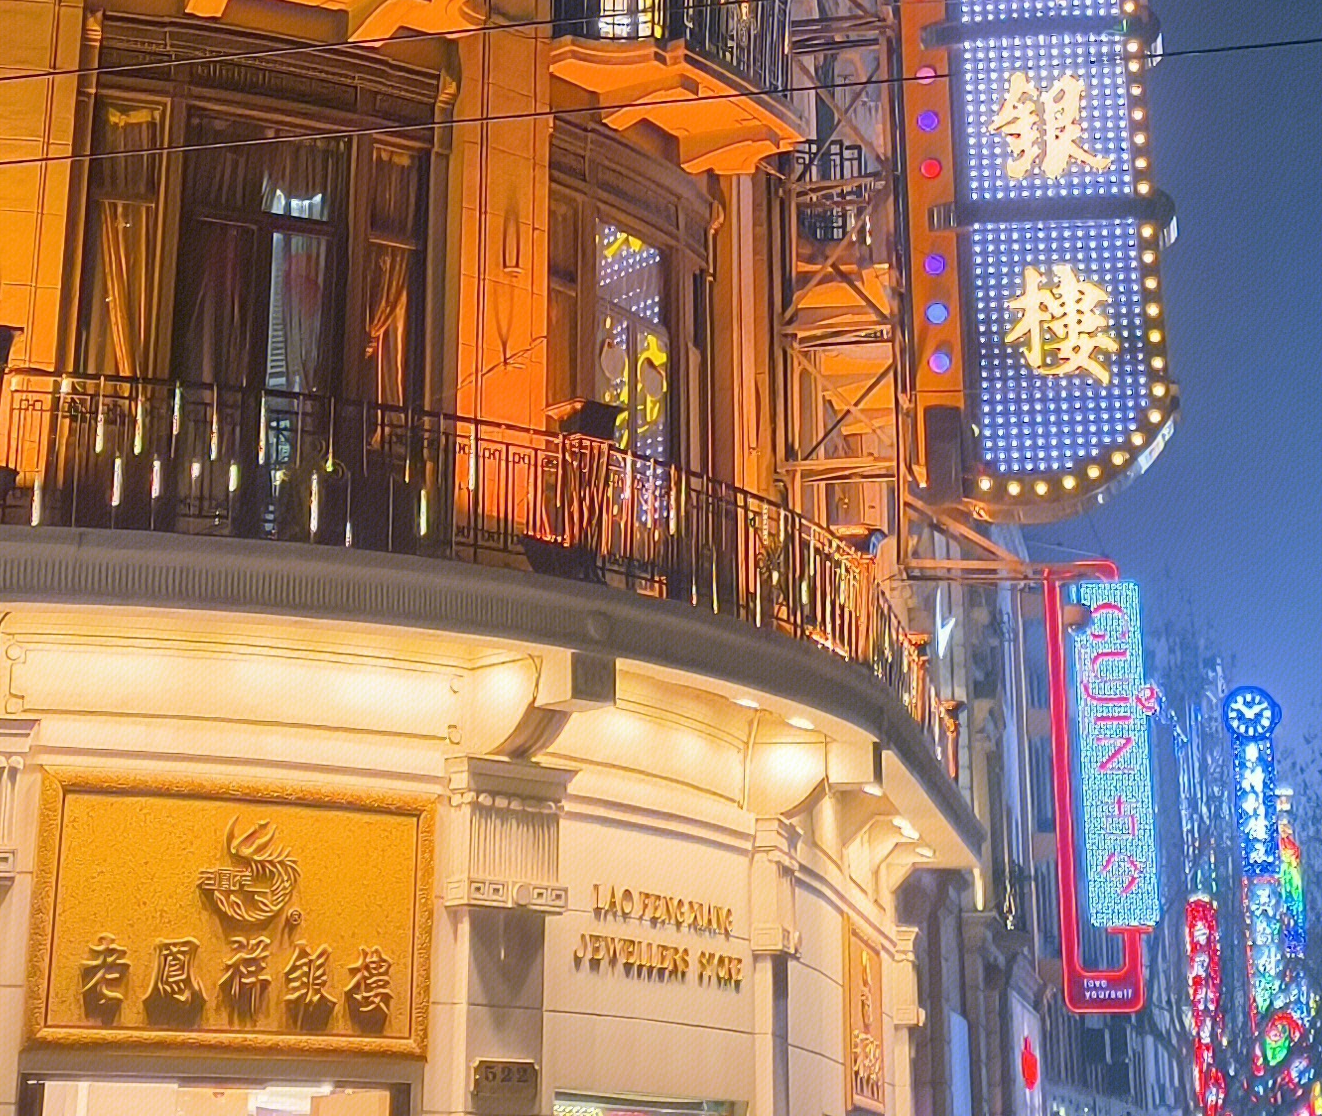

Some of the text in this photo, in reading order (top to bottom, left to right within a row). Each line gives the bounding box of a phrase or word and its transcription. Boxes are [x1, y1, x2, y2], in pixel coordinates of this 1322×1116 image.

[1082, 601, 1135, 773] GUJIN
[593, 884, 733, 933] LAO FENG XIANG
[81, 932, 394, 1015] 老鳳祥銀樓
[575, 933, 744, 982] JEWELLERS STORE
[1084, 979, 1107, 988] love
[484, 1065, 529, 1083] 522
